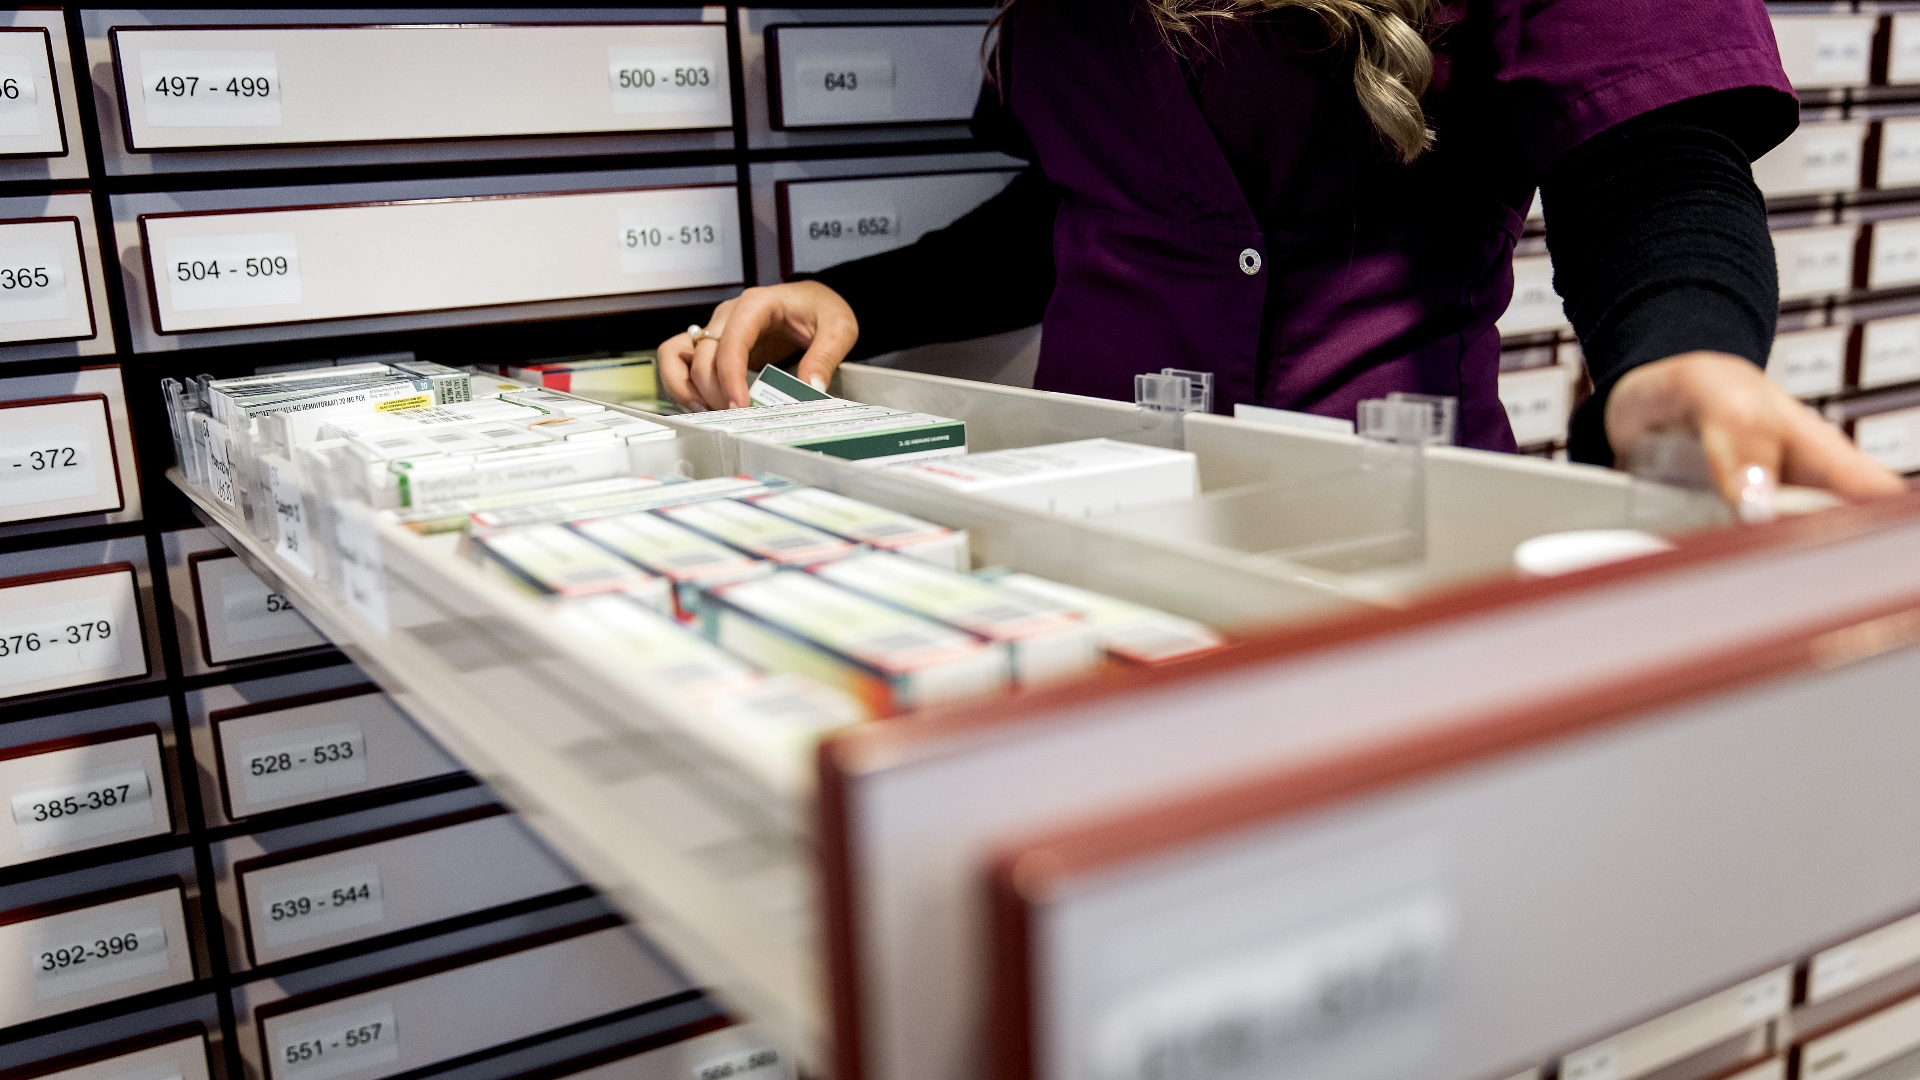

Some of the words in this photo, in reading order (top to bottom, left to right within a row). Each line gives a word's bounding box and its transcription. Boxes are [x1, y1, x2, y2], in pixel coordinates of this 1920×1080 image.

[0, 78, 20, 100] 6
[155, 76, 200, 97] 497
[225, 77, 270, 98] 499
[619, 69, 655, 88] 500
[675, 68, 711, 87] 503
[824, 71, 858, 91] 643
[626, 228, 662, 248] 510
[680, 225, 715, 245] 513
[809, 221, 842, 240] 649
[857, 217, 890, 237] 652
[0, 267, 49, 290] 365
[177, 260, 221, 282] 504
[246, 256, 288, 277] 509
[30, 447, 77, 471] 372
[0, 632, 41, 657] 376
[66, 620, 112, 645] 379
[251, 752, 292, 777] 528
[313, 741, 354, 765] 533
[33, 784, 130, 822] 385-387
[271, 896, 312, 922] 539
[331, 883, 370, 908] 544
[41, 932, 139, 972] 392-396
[286, 1040, 323, 1064] 551
[345, 1022, 383, 1048] 557
